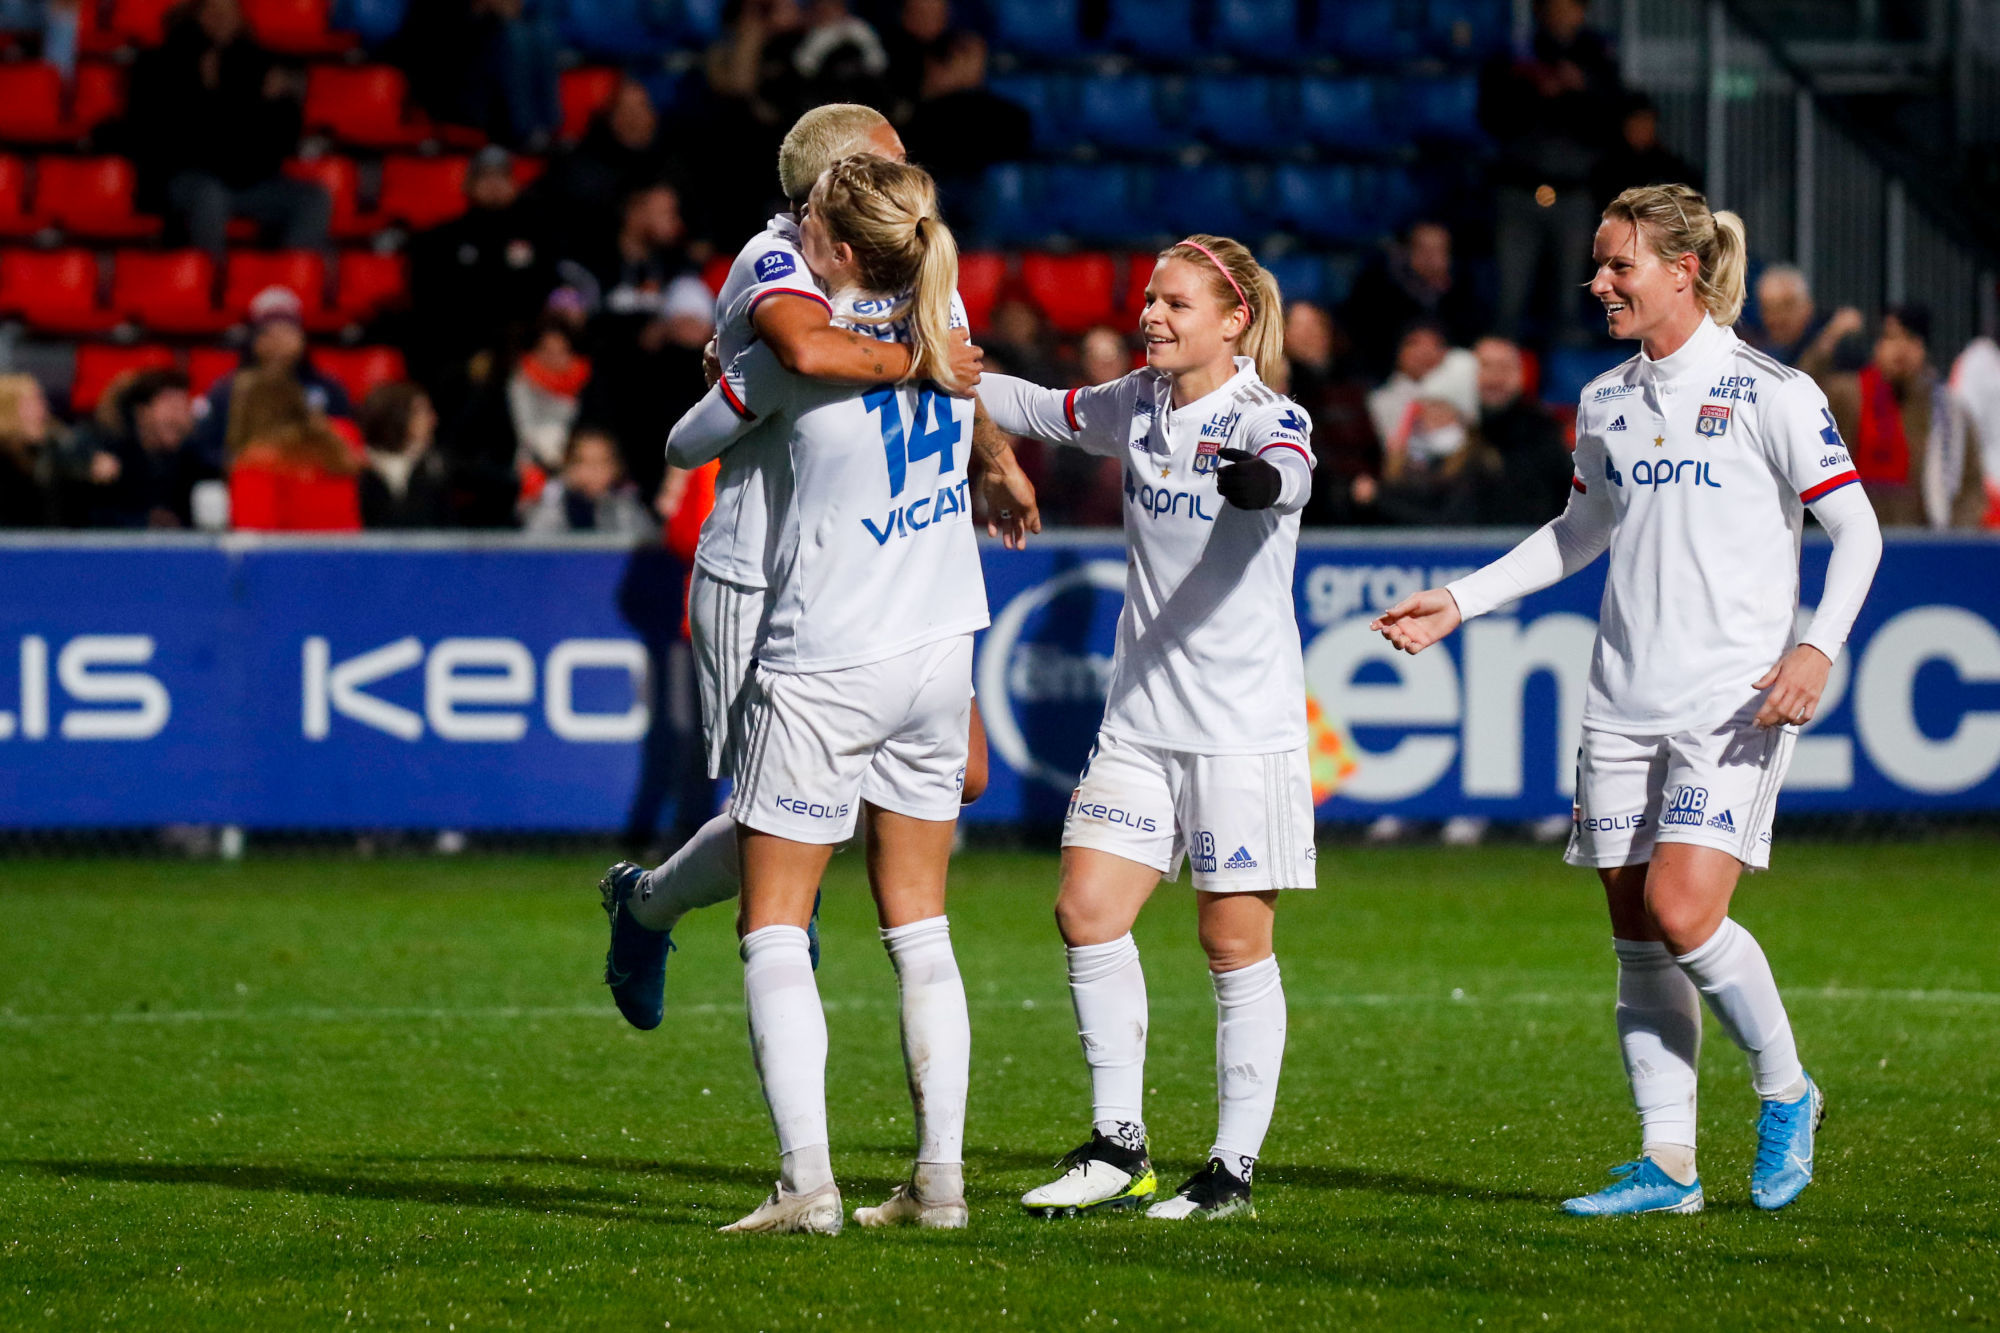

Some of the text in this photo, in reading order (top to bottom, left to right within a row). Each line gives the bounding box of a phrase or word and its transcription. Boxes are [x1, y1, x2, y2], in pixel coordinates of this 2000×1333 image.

[763, 254, 784, 269] D1
[761, 265, 794, 280] ARKEMA
[1594, 384, 1636, 399] SWORD
[861, 383, 961, 499] 14
[1632, 459, 1722, 492] april
[1139, 485, 1214, 521] april
[861, 479, 970, 546] VICAT
[1669, 786, 1708, 811] JOB
[1665, 810, 1704, 826] STATION
[1707, 819, 1736, 834] adidas
[1223, 859, 1257, 869] adidas
